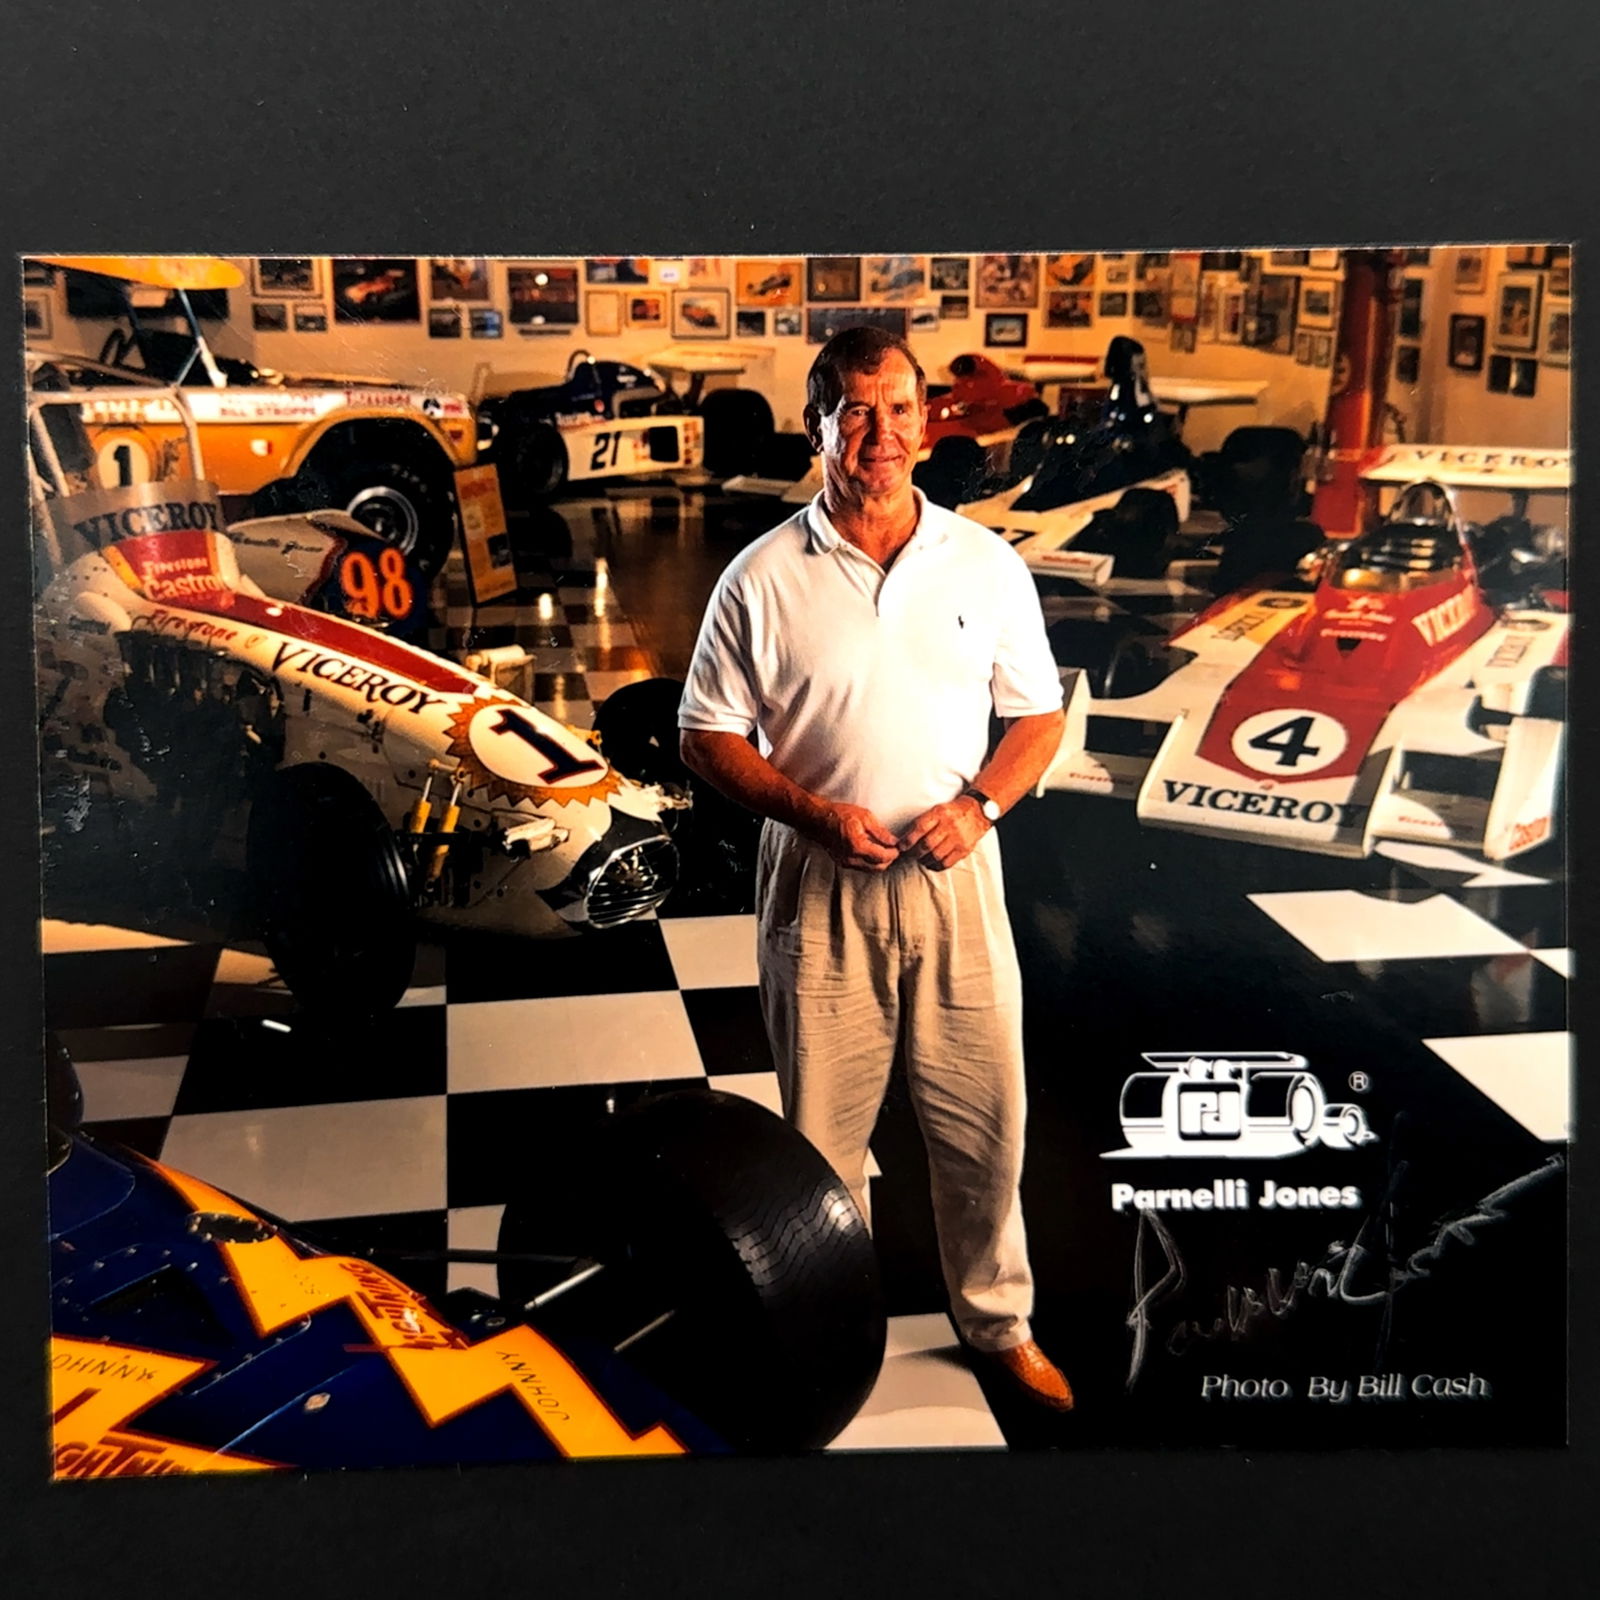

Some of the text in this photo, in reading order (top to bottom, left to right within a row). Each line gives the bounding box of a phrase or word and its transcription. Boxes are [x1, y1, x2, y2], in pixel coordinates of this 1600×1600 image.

[113, 445, 133, 488] 1
[590, 431, 623, 471] 21
[1414, 450, 1569, 469] VICERO
[74, 501, 220, 555] VICEROY
[341, 548, 412, 619] 98
[269, 641, 448, 715] VICEROY
[489, 708, 605, 785] 1
[1248, 716, 1320, 767] 4
[1163, 779, 1369, 829] VICEROY
[496, 1350, 571, 1421] JOHNNY
